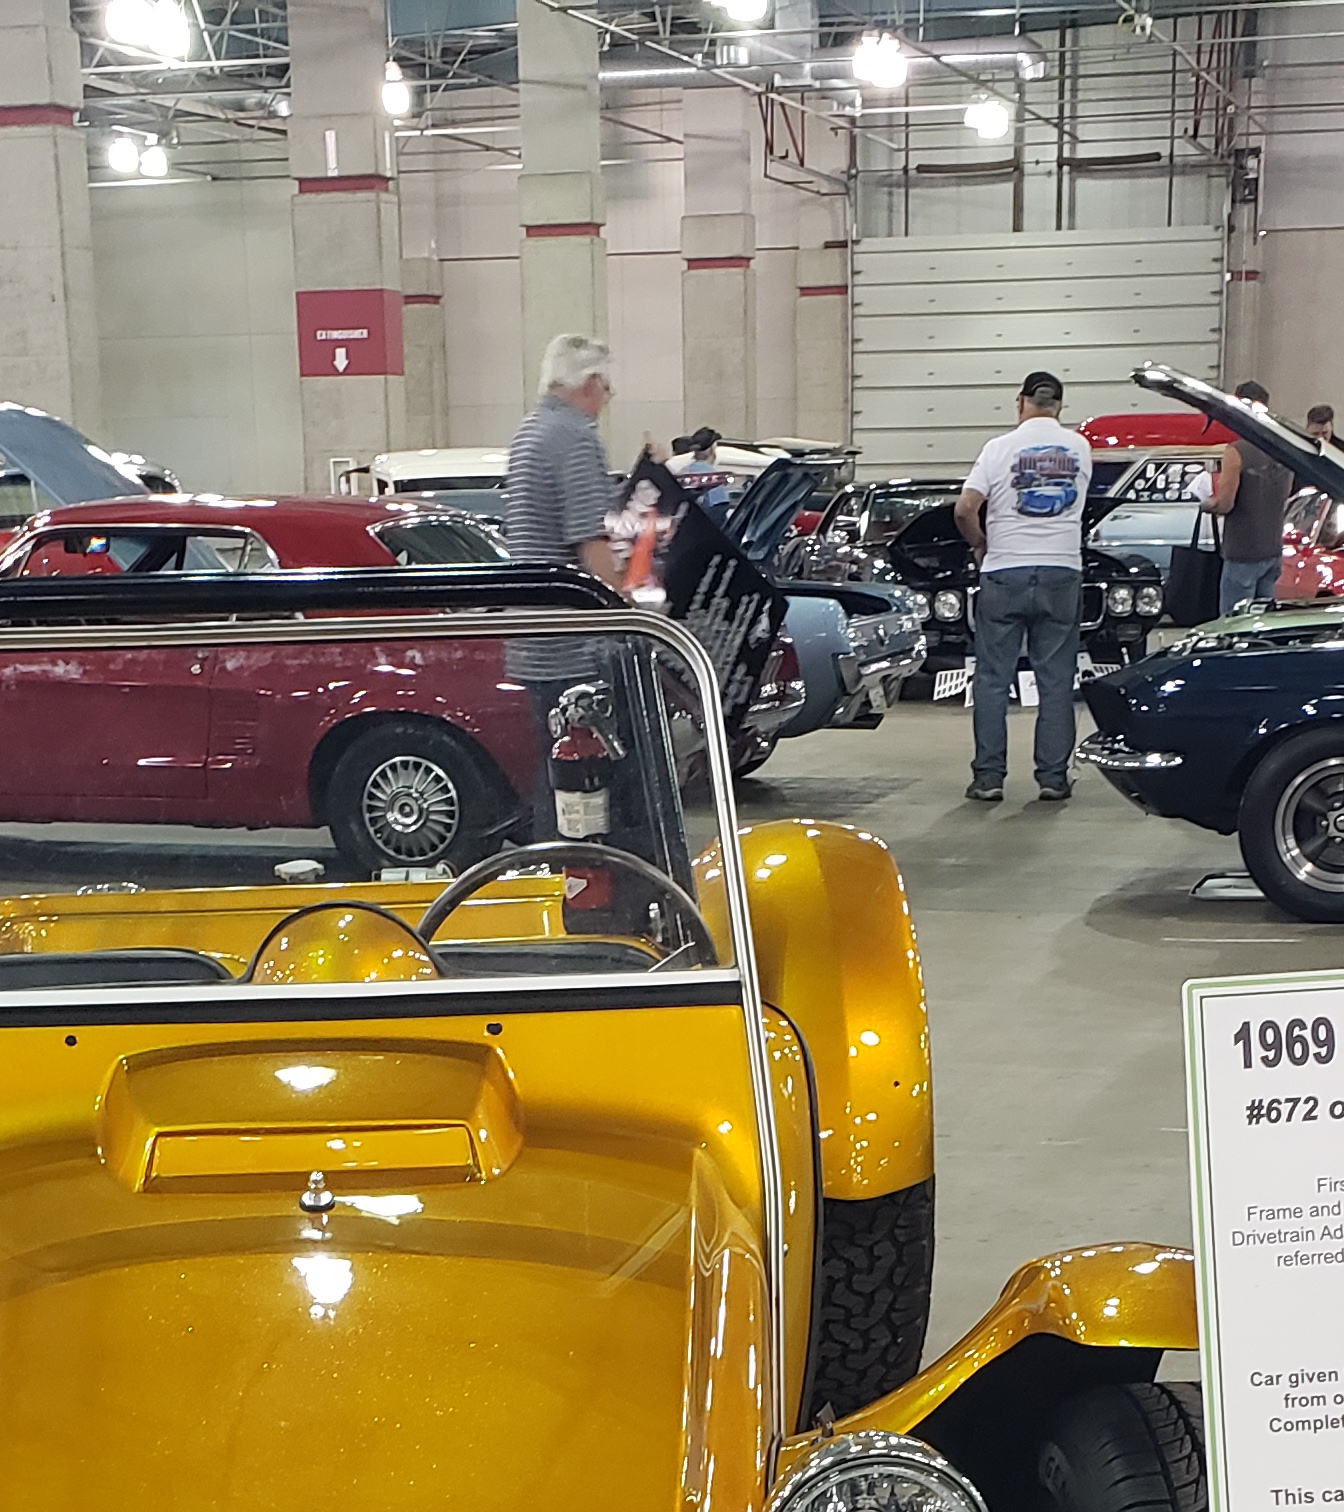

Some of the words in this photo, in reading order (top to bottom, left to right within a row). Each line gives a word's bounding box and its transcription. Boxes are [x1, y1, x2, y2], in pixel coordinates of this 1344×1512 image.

[1232, 1015, 1337, 1071] 1969
[1244, 1094, 1320, 1127] #672
[1246, 1204, 1305, 1223] Frame
[1308, 1199, 1343, 1219] and
[1230, 1225, 1317, 1248] Drivetrain
[1249, 1370, 1284, 1388] Car
[1287, 1367, 1340, 1390] given
[1282, 1391, 1328, 1410] from
[1268, 1486, 1316, 1507] This
